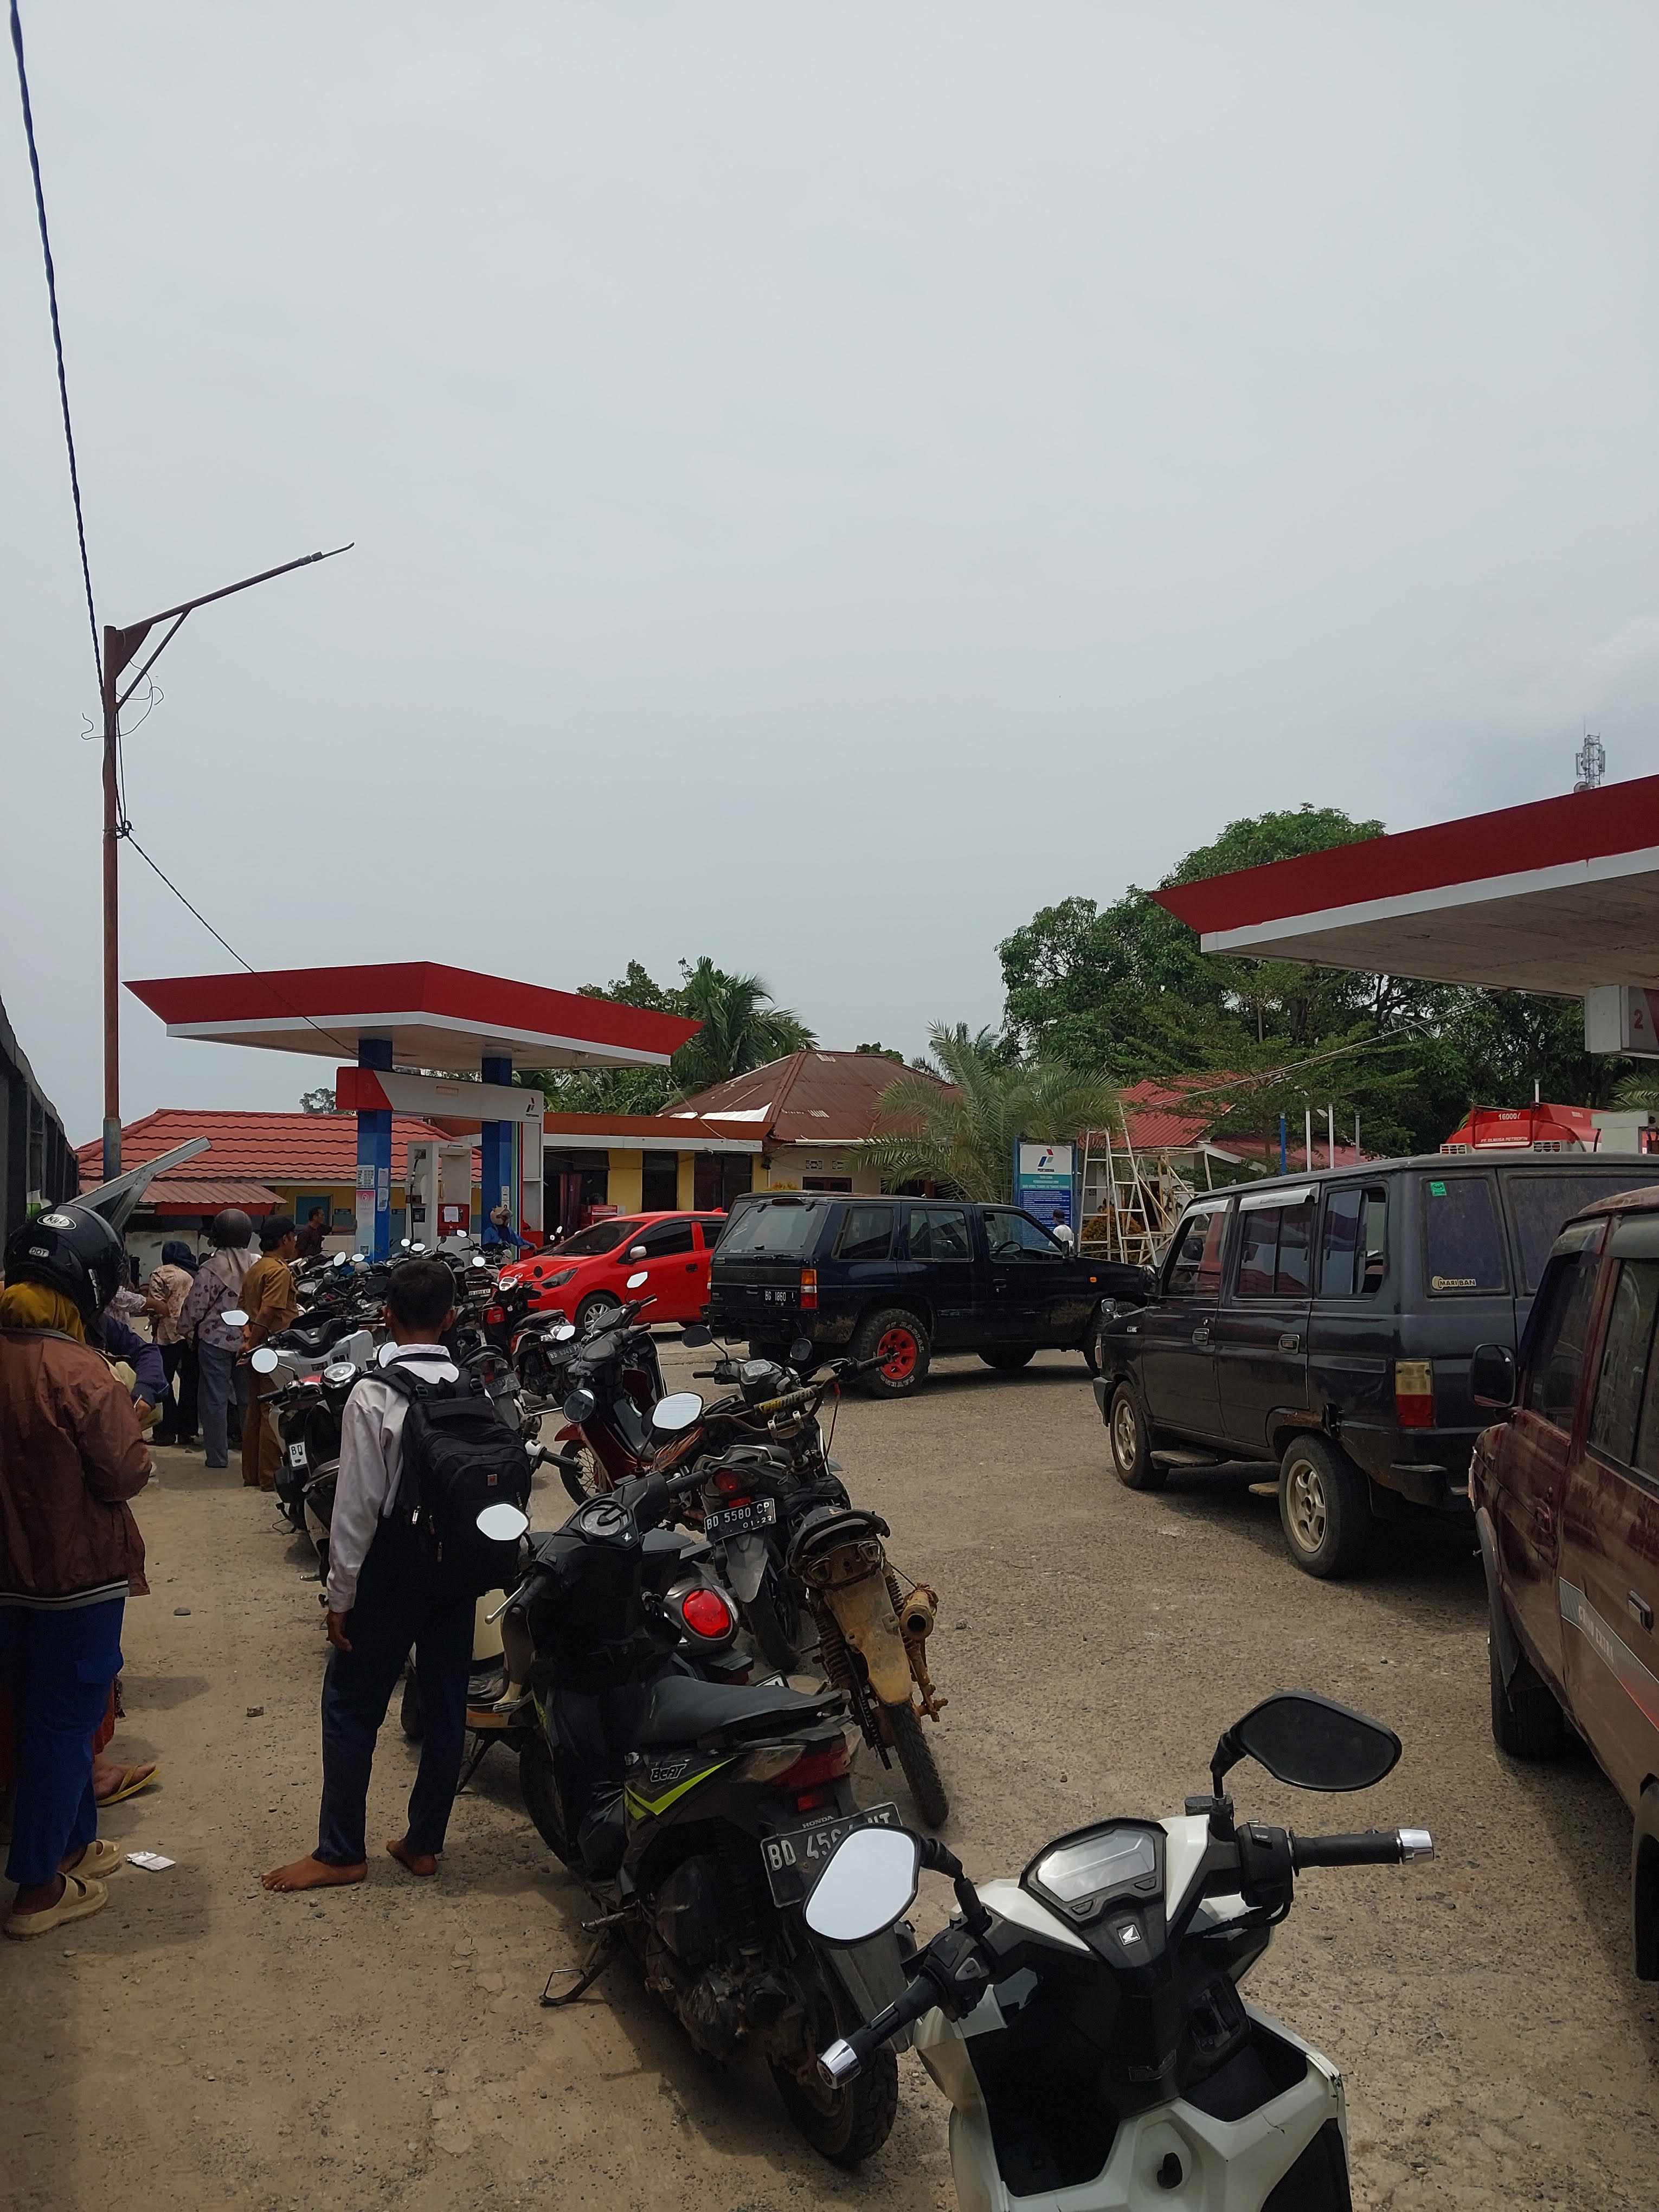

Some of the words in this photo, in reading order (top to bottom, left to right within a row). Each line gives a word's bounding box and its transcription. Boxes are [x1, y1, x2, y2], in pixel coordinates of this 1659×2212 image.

[1634, 1009, 1643, 1028] 2
[765, 1291, 771, 1301] BG
[775, 1291, 786, 1302] 1860
[899, 1321, 924, 1353] RADIAL
[880, 1375, 916, 1388] SAVERO
[706, 1515, 719, 1529] BD
[724, 1507, 751, 1523] 5580
[756, 1502, 770, 1514] CP
[802, 1815, 834, 1829] HONDA
[768, 1840, 796, 1871] BD
